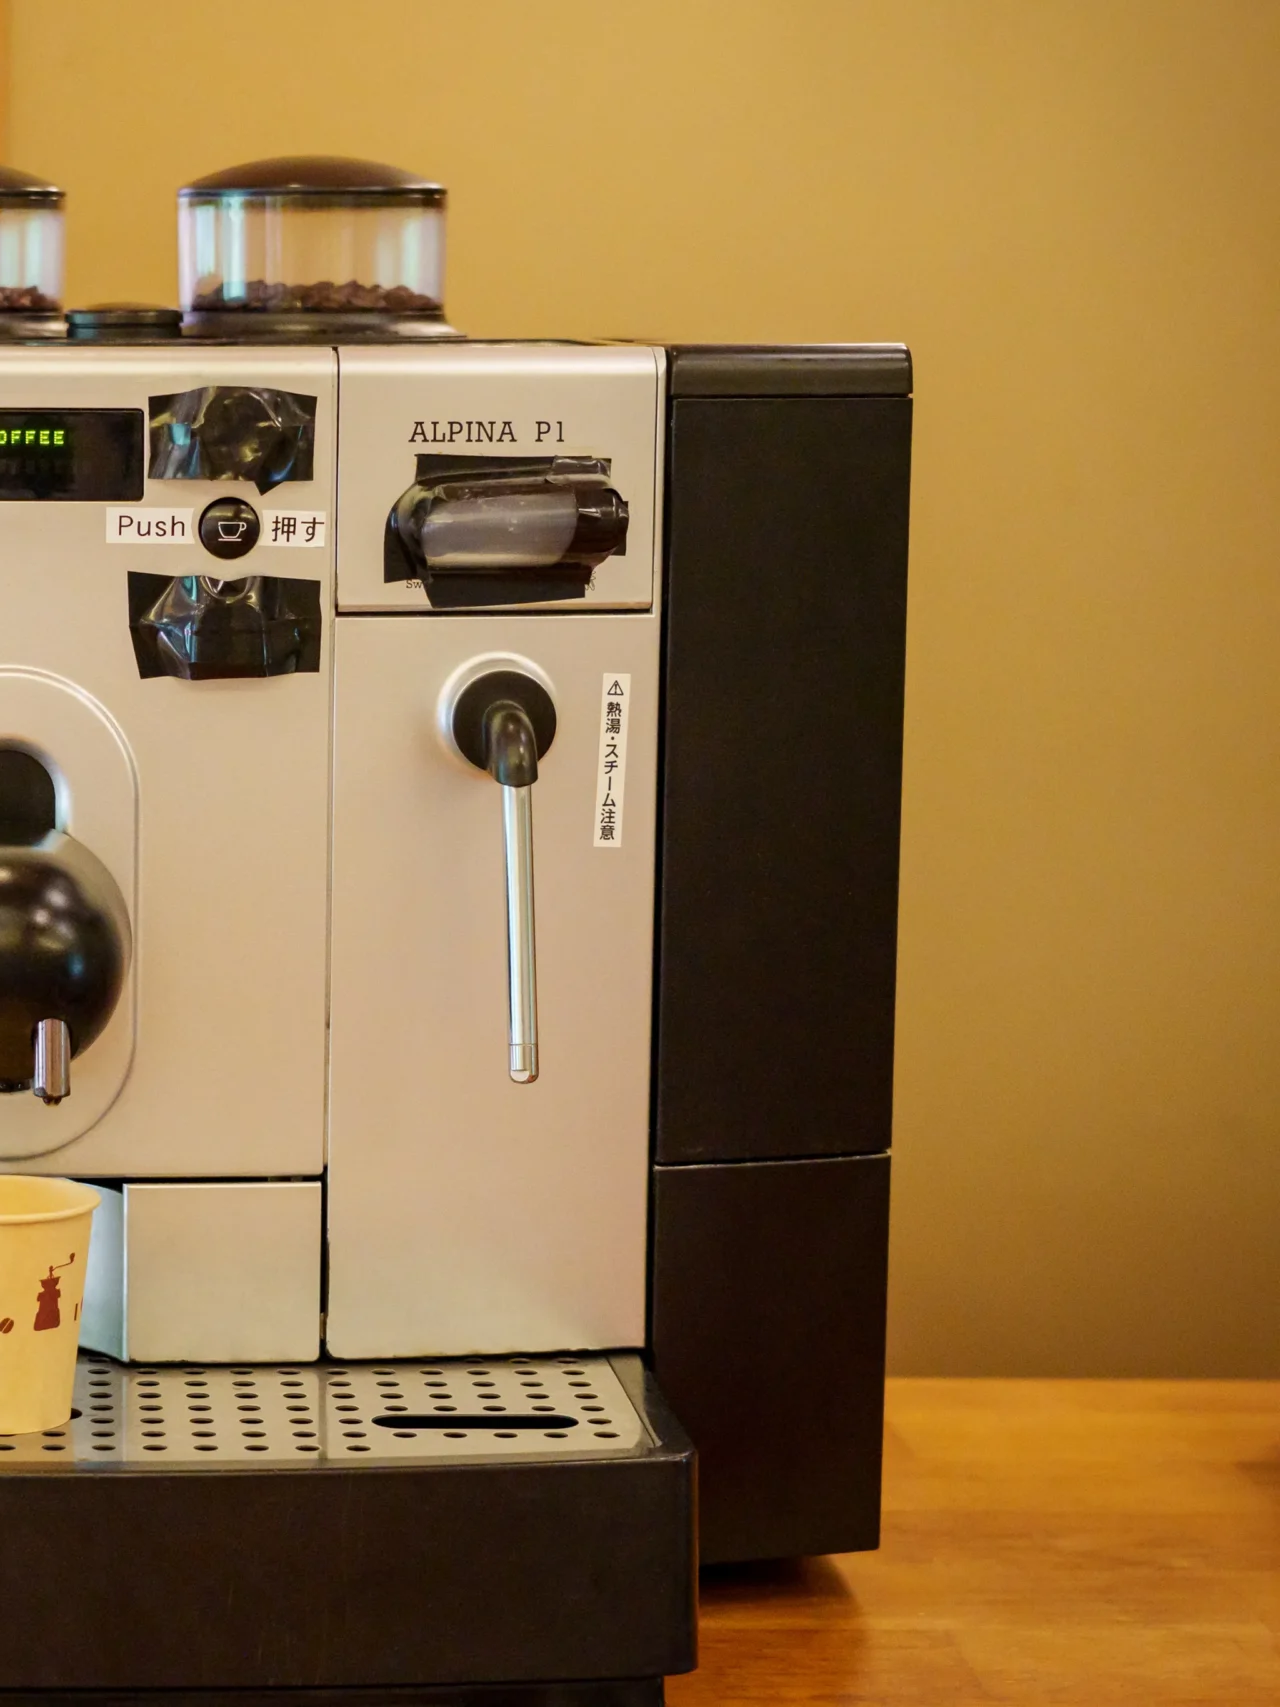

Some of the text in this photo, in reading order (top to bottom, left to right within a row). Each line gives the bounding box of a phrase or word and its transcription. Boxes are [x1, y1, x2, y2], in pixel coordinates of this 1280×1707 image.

[408, 421, 518, 443] ALPINA
[118, 514, 187, 538] Push
[271, 516, 325, 543] 押す
[599, 701, 622, 841] 熱湯・スチーム注意
